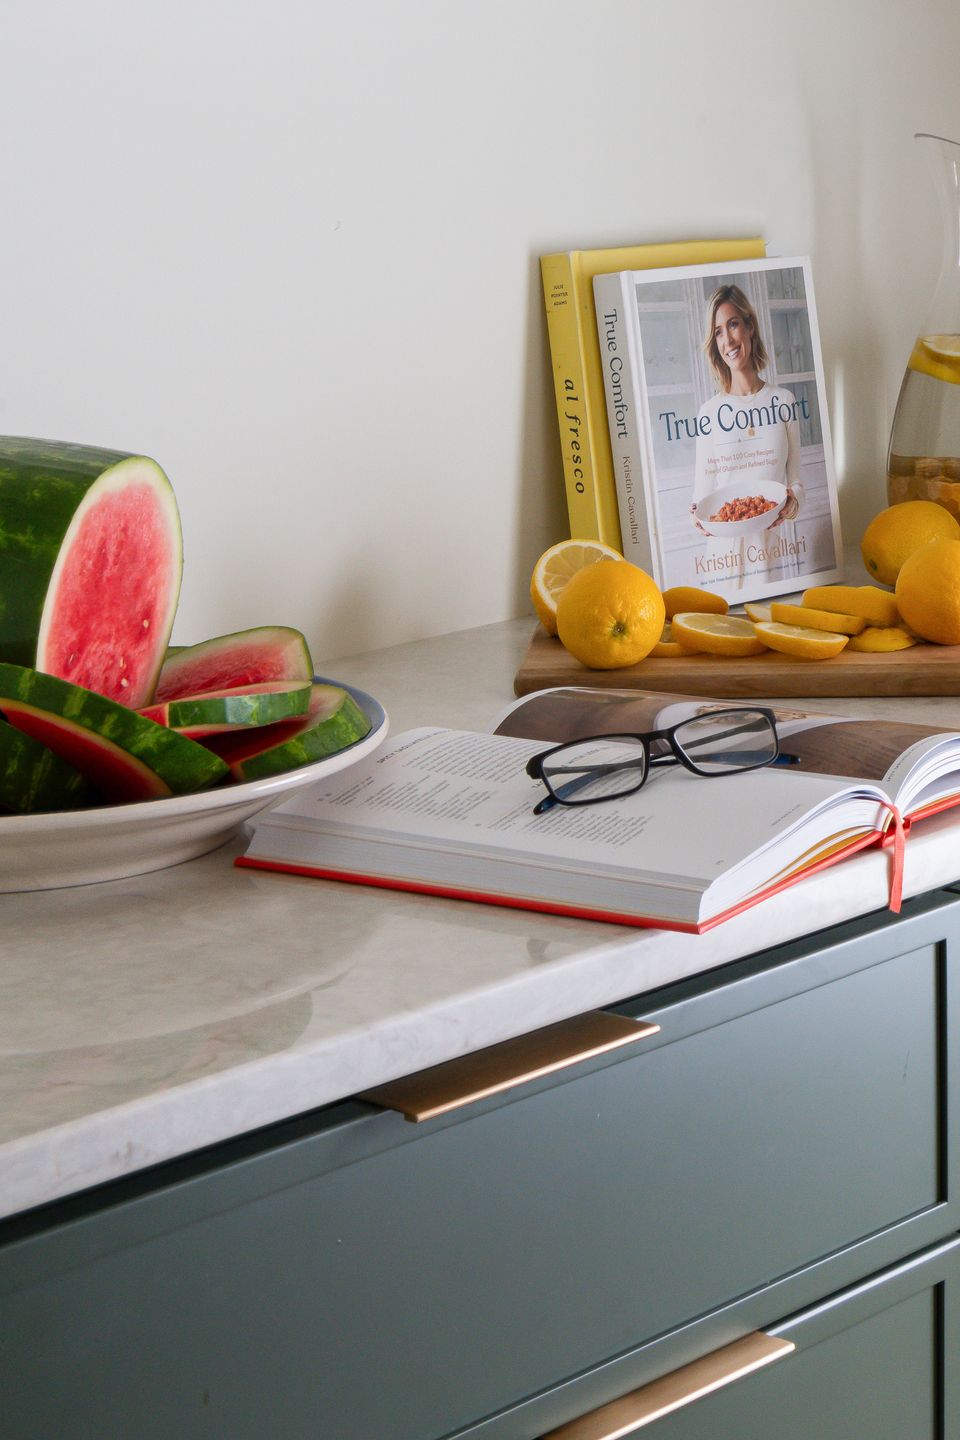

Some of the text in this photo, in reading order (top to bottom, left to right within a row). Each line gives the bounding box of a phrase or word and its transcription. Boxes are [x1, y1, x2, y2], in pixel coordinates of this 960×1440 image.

[564, 378, 585, 494] al fresco
[604, 308, 640, 546] True Comfort Kristin Cavallari
[658, 395, 810, 441] True Comfort
[694, 550, 744, 575] Kristin
[746, 535, 807, 563] Cavallari
